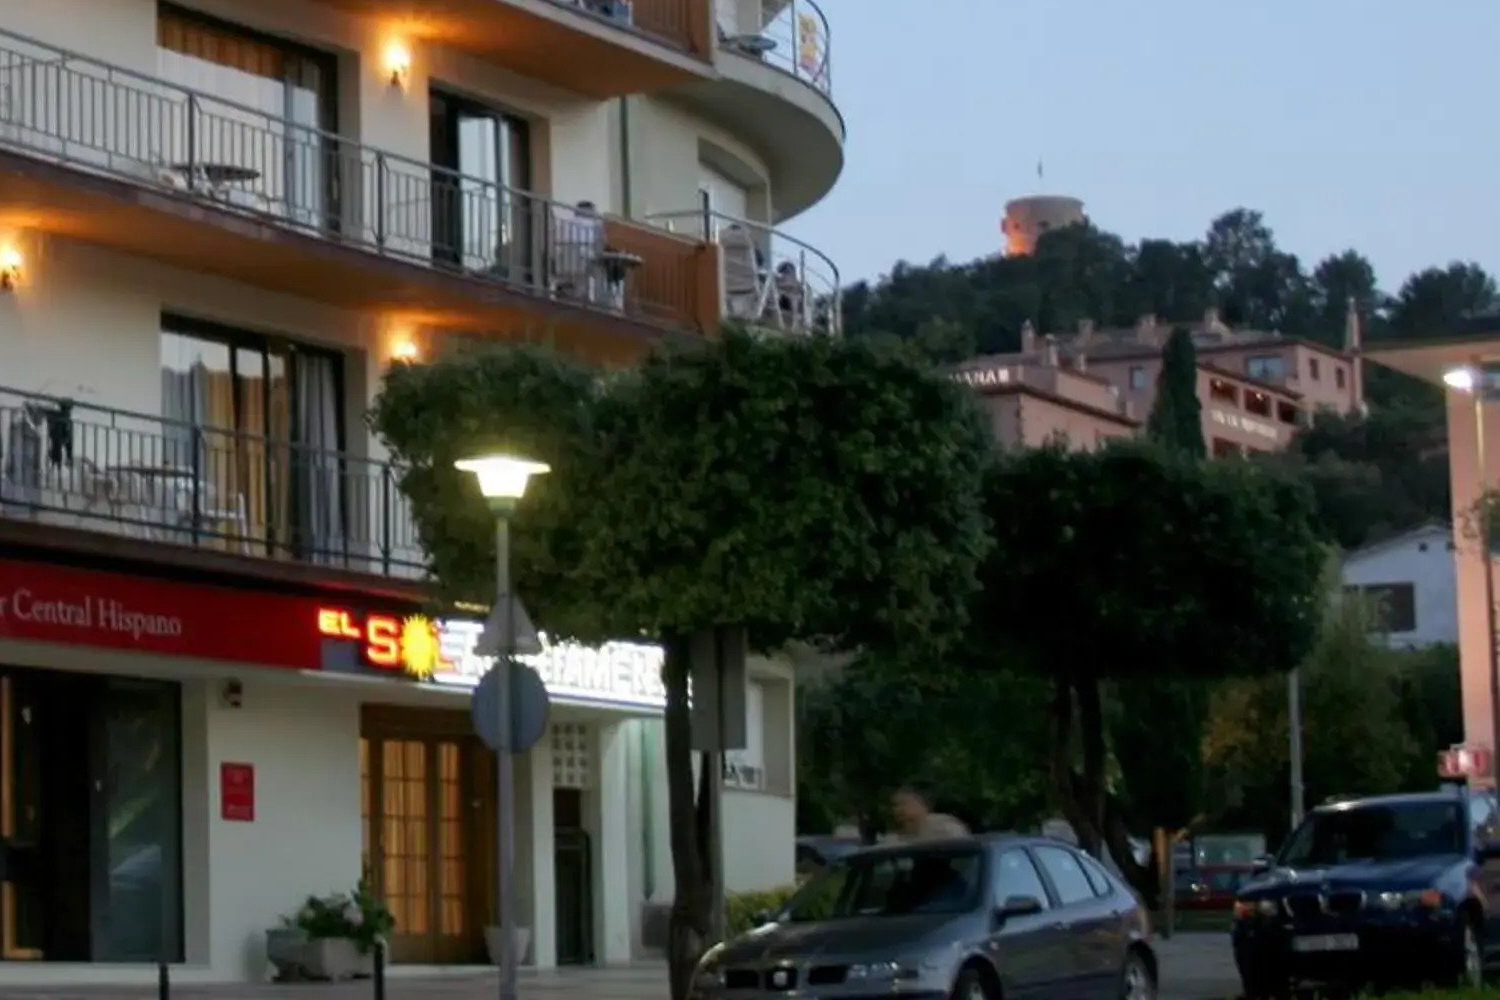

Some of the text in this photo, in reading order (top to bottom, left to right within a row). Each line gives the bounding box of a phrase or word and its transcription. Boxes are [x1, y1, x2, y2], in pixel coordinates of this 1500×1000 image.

[13, 589, 93, 628] Central
[98, 599, 181, 639] Hispano
[319, 609, 360, 637] EL
